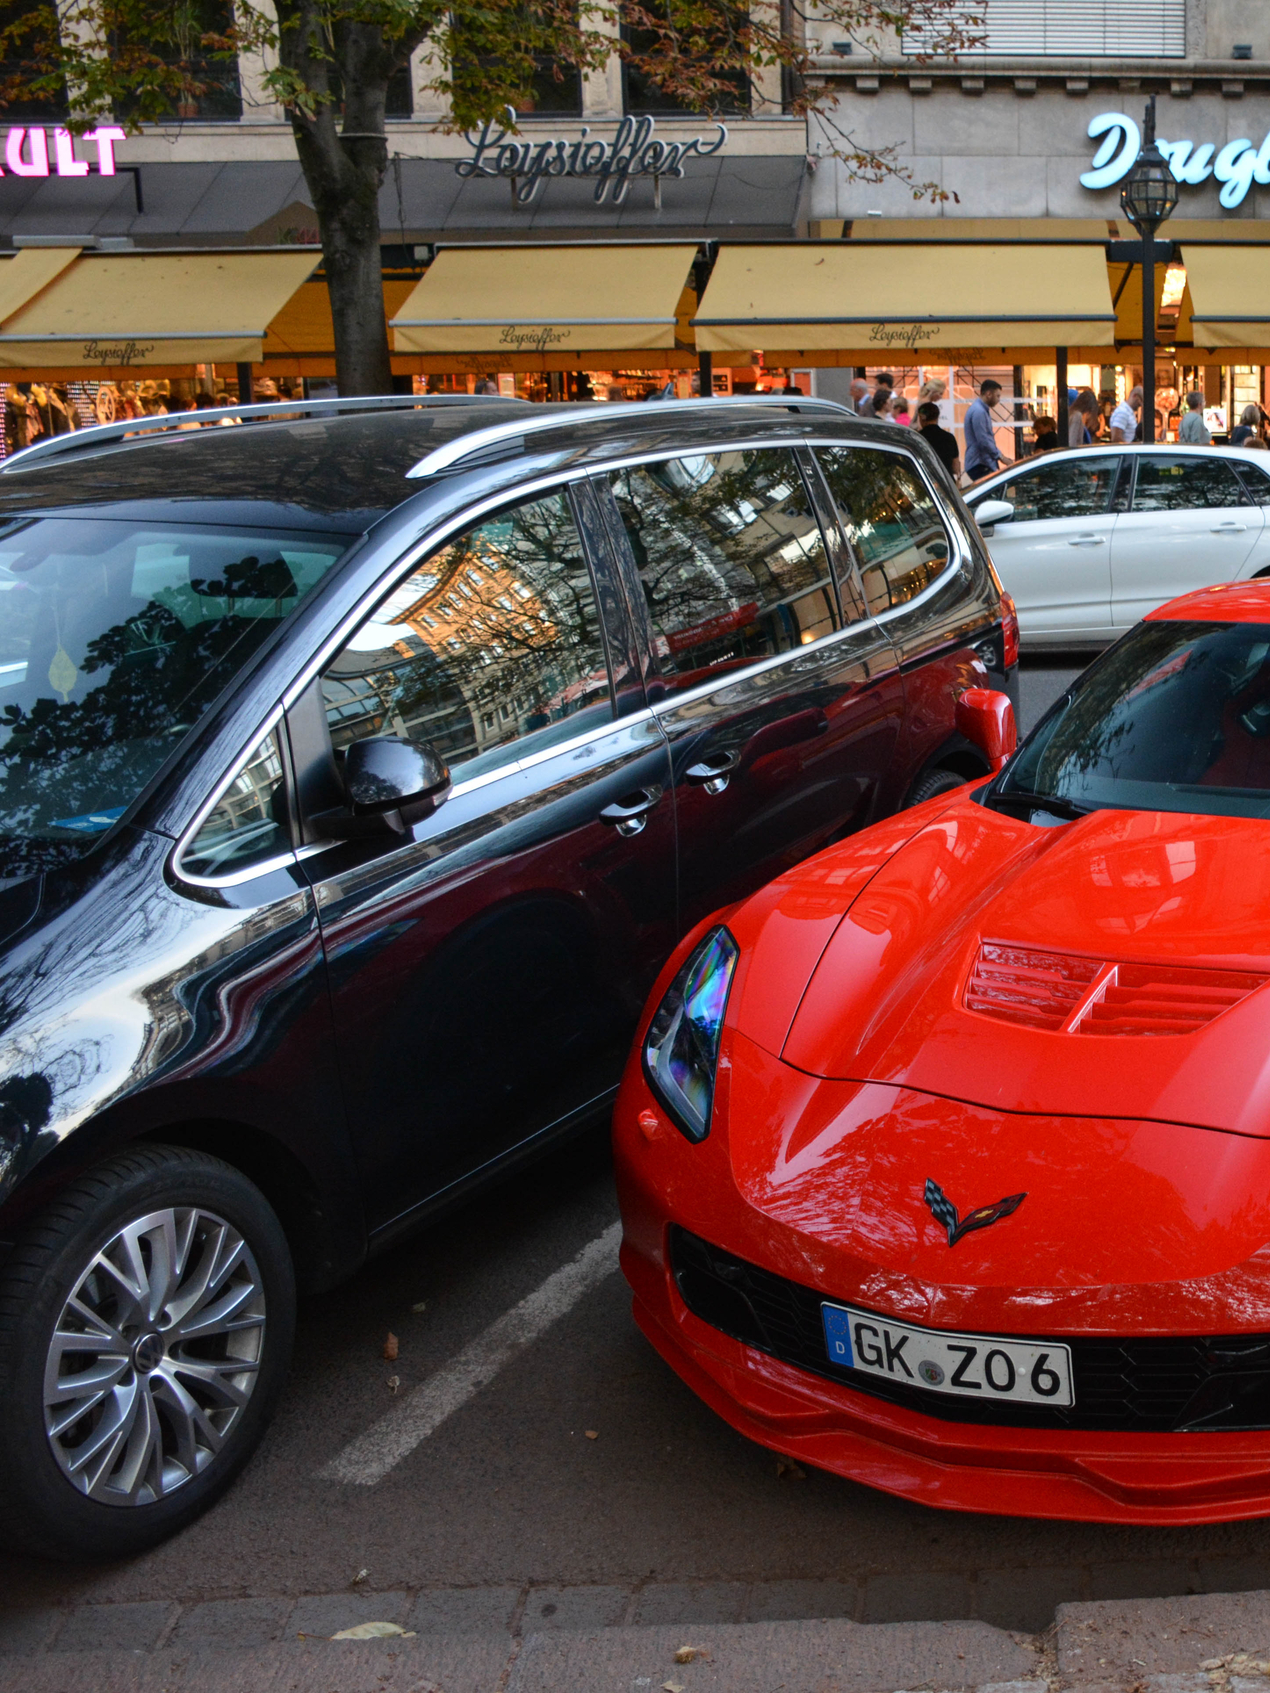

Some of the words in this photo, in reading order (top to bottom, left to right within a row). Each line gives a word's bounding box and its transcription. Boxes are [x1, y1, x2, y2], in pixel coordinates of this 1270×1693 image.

[0, 127, 126, 177] ULT
[455, 104, 728, 205] Leysieffer
[869, 323, 940, 347] Leysieffer
[835, 1341, 845, 1354] D
[854, 1322, 914, 1378] GK
